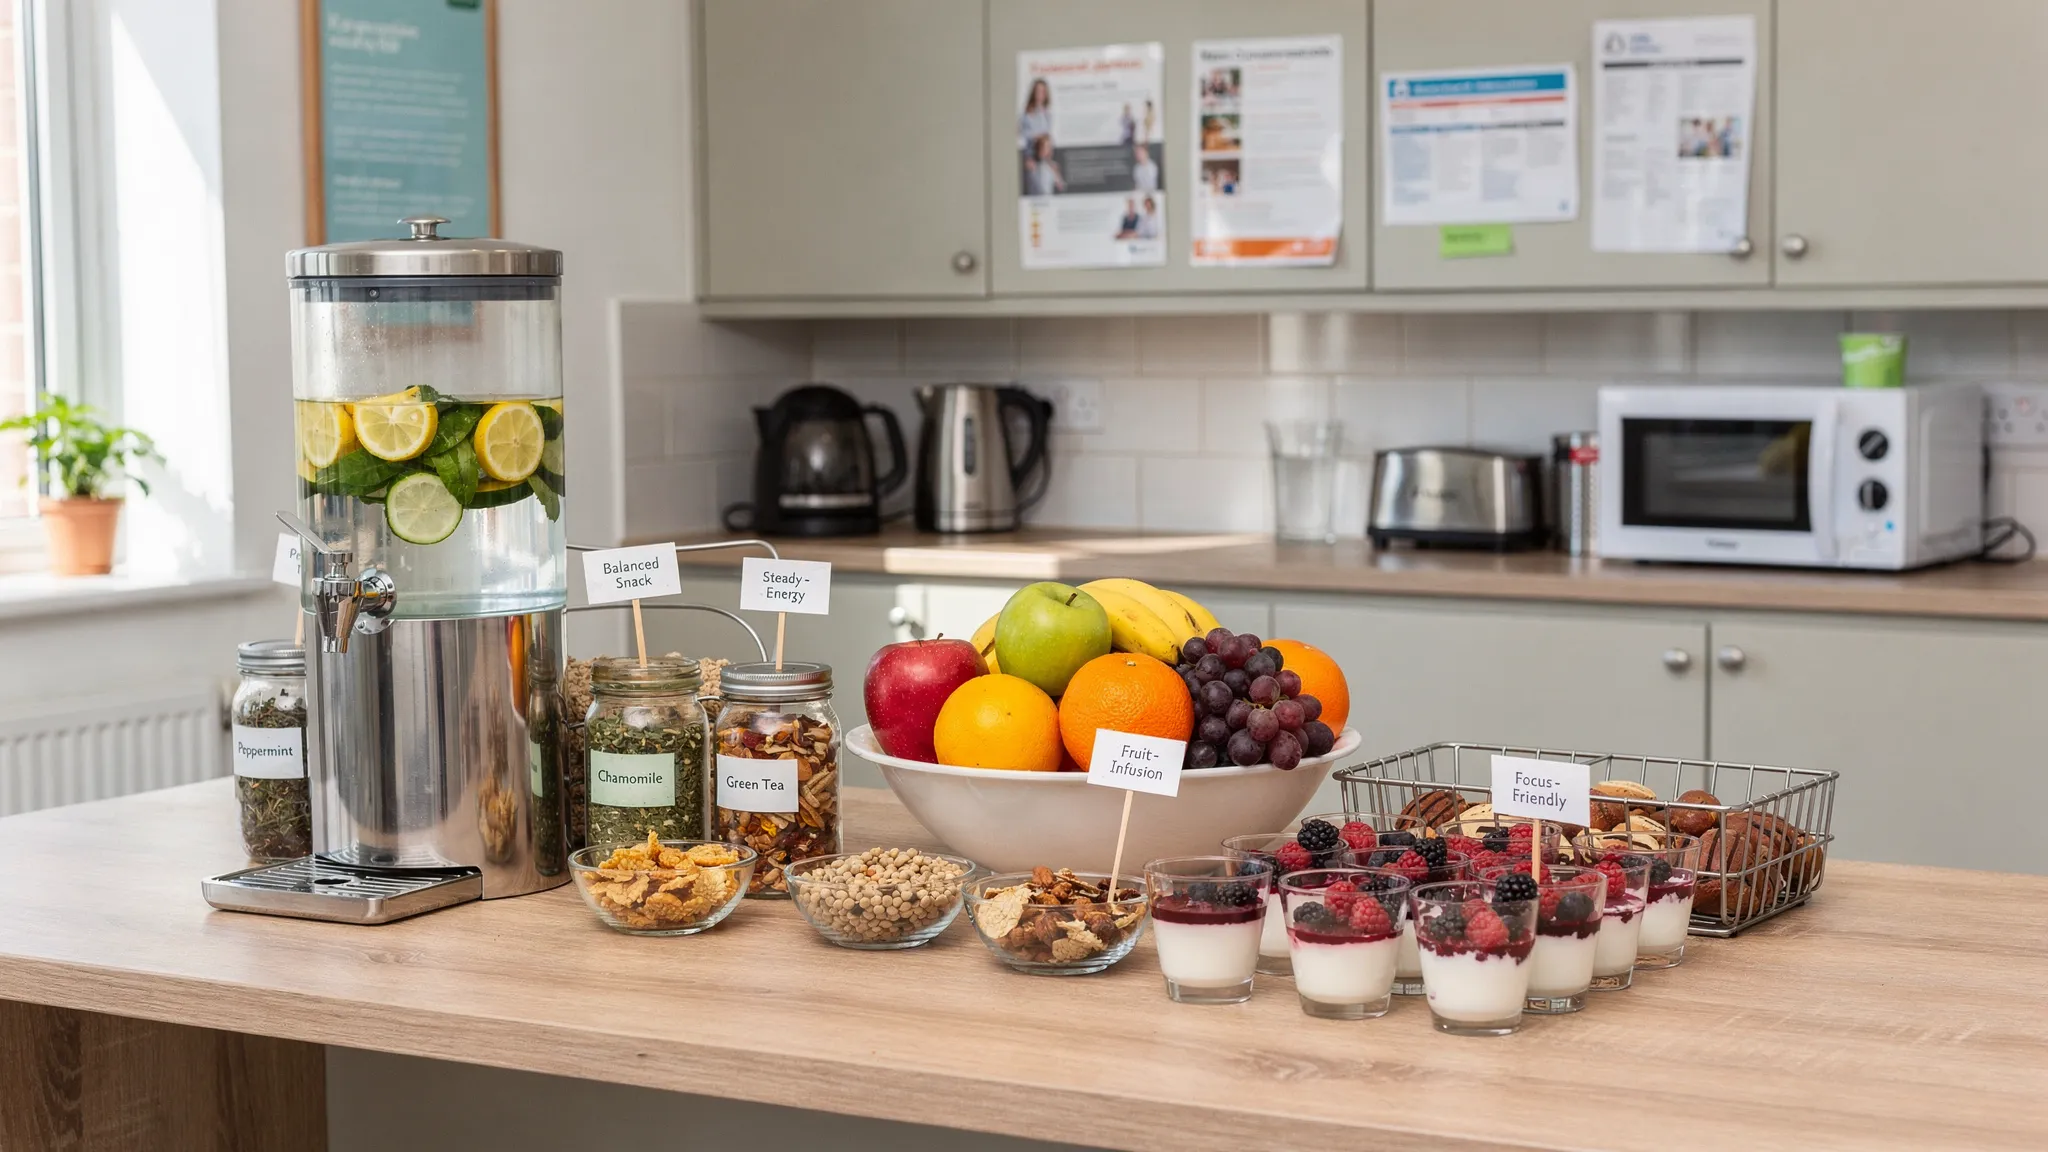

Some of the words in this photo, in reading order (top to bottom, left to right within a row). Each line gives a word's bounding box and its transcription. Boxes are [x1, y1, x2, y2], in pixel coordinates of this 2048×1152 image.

[603, 556, 660, 575] Balanced
[616, 574, 653, 589] Snack
[766, 586, 806, 604] Energy
[238, 741, 293, 759] Peppermint
[1121, 744, 1159, 761] Fruit-
[598, 769, 663, 785] Chamomile
[1109, 760, 1163, 780] Infusion
[726, 775, 759, 790] Green
[761, 778, 785, 791] Tea
[1515, 771, 1561, 788] Focus-
[1512, 788, 1567, 811] Friendly
